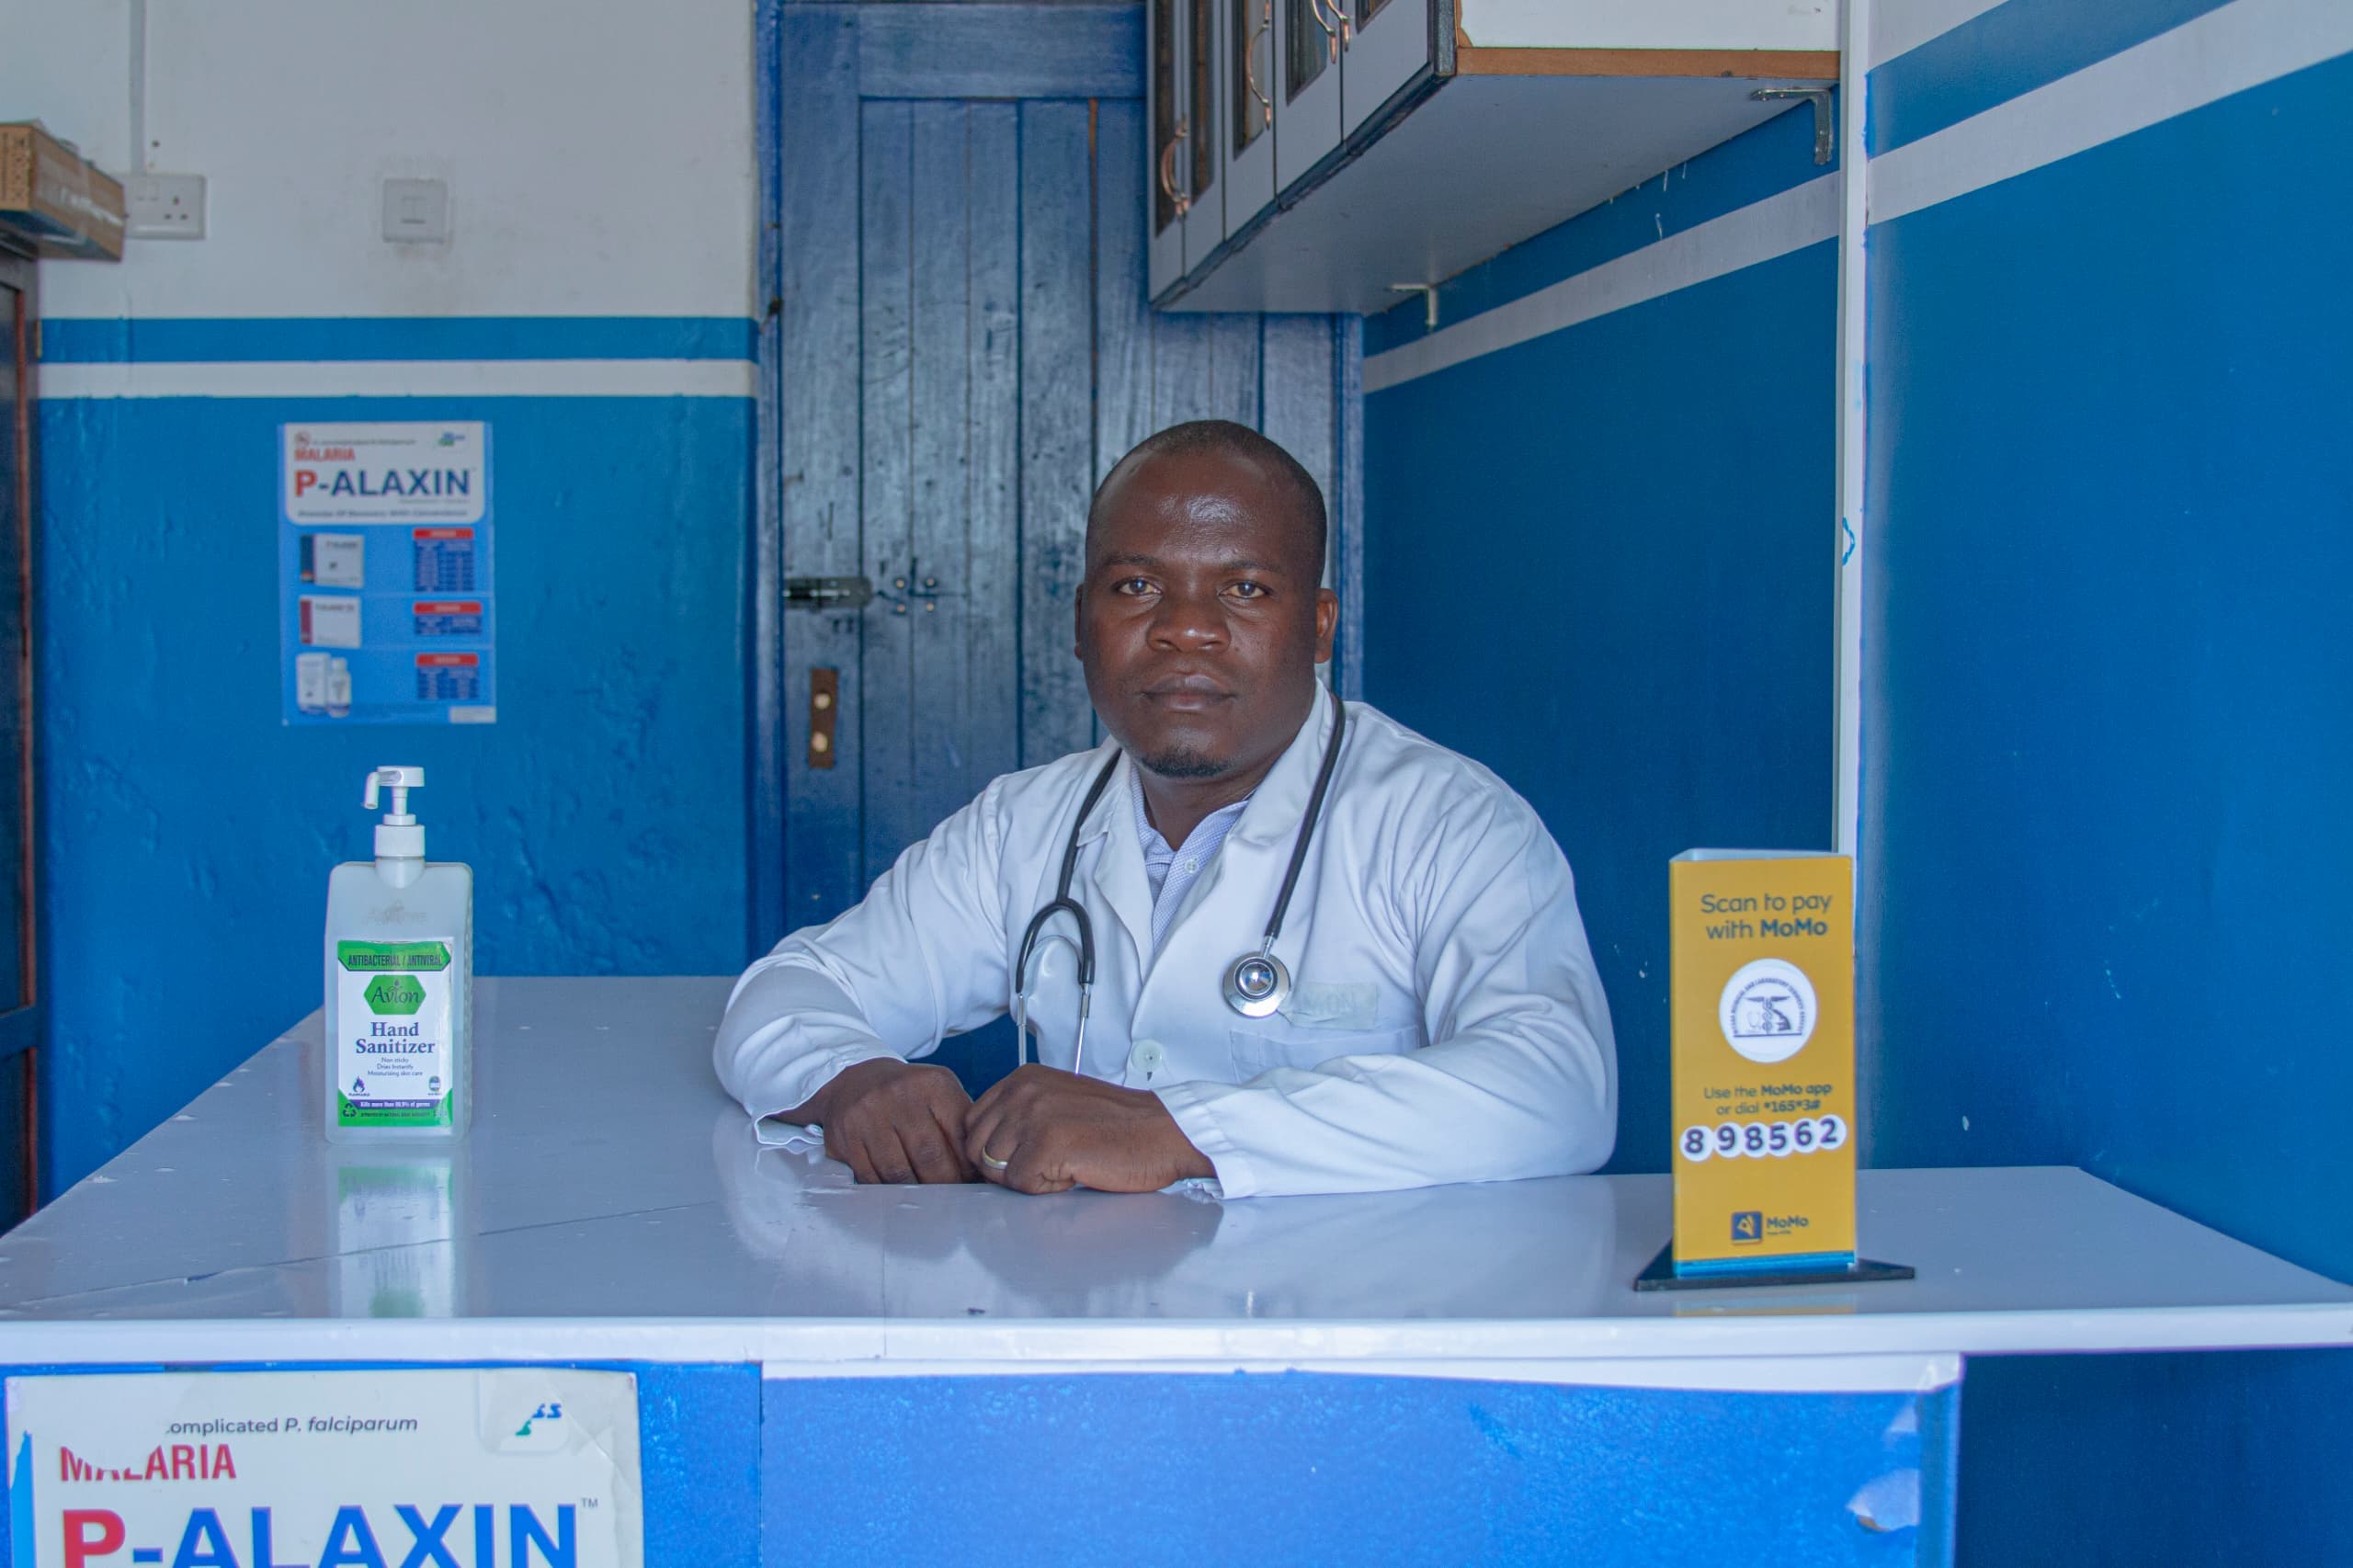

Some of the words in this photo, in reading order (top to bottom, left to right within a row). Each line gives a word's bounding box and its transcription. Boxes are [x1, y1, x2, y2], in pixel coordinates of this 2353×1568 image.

[294, 447, 356, 461] MALARIA
[294, 469, 470, 497] P-ALAXIN
[1700, 894, 1757, 914] Scan
[1765, 893, 1786, 912] to
[1792, 895, 1833, 915] pay
[1706, 920, 1754, 939] with
[1760, 918, 1827, 937] MoMo
[349, 955, 400, 966] ANTIBACTERIAL
[407, 955, 441, 966] ANTIVIRAL
[371, 985, 419, 1004] Avion
[370, 1022, 419, 1037] Hand
[356, 1039, 435, 1053] Sanitizer
[1704, 1087, 1731, 1099] Use
[1734, 1086, 1756, 1097] the
[1761, 1085, 1802, 1096] MoMo
[1806, 1084, 1832, 1095] app
[1716, 1106, 1732, 1116] or
[1735, 1102, 1759, 1115] dial
[1766, 1215, 1809, 1229] MoMo
[165, 1418, 278, 1437] omplicated
[285, 1417, 301, 1433] P.
[308, 1415, 418, 1436] falciparum
[63, 1504, 577, 1568] P-ALAXIN
